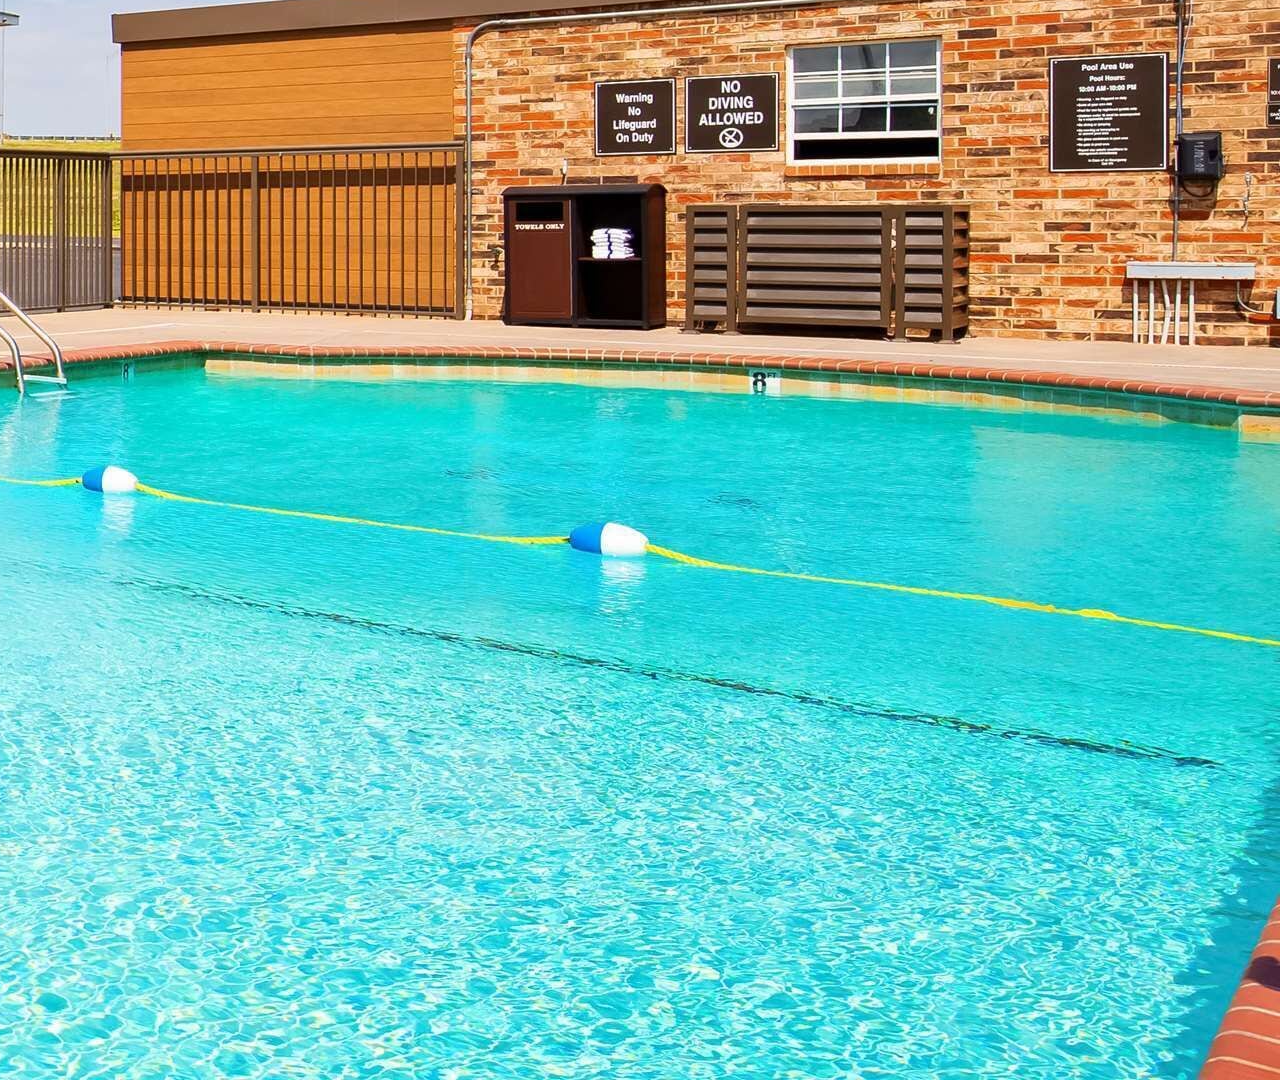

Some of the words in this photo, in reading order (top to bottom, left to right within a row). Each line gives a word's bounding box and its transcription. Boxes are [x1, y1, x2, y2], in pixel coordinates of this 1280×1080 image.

[1119, 62, 1134, 70] Use
[721, 80, 740, 94] NO
[615, 93, 654, 104] Warning
[708, 96, 753, 110] DIVING
[628, 106, 641, 116] No
[613, 118, 657, 131] Lifeguard
[698, 112, 764, 126] ALLOWED
[616, 133, 629, 143] On
[632, 132, 654, 144] Duty
[752, 371, 767, 393] 8
